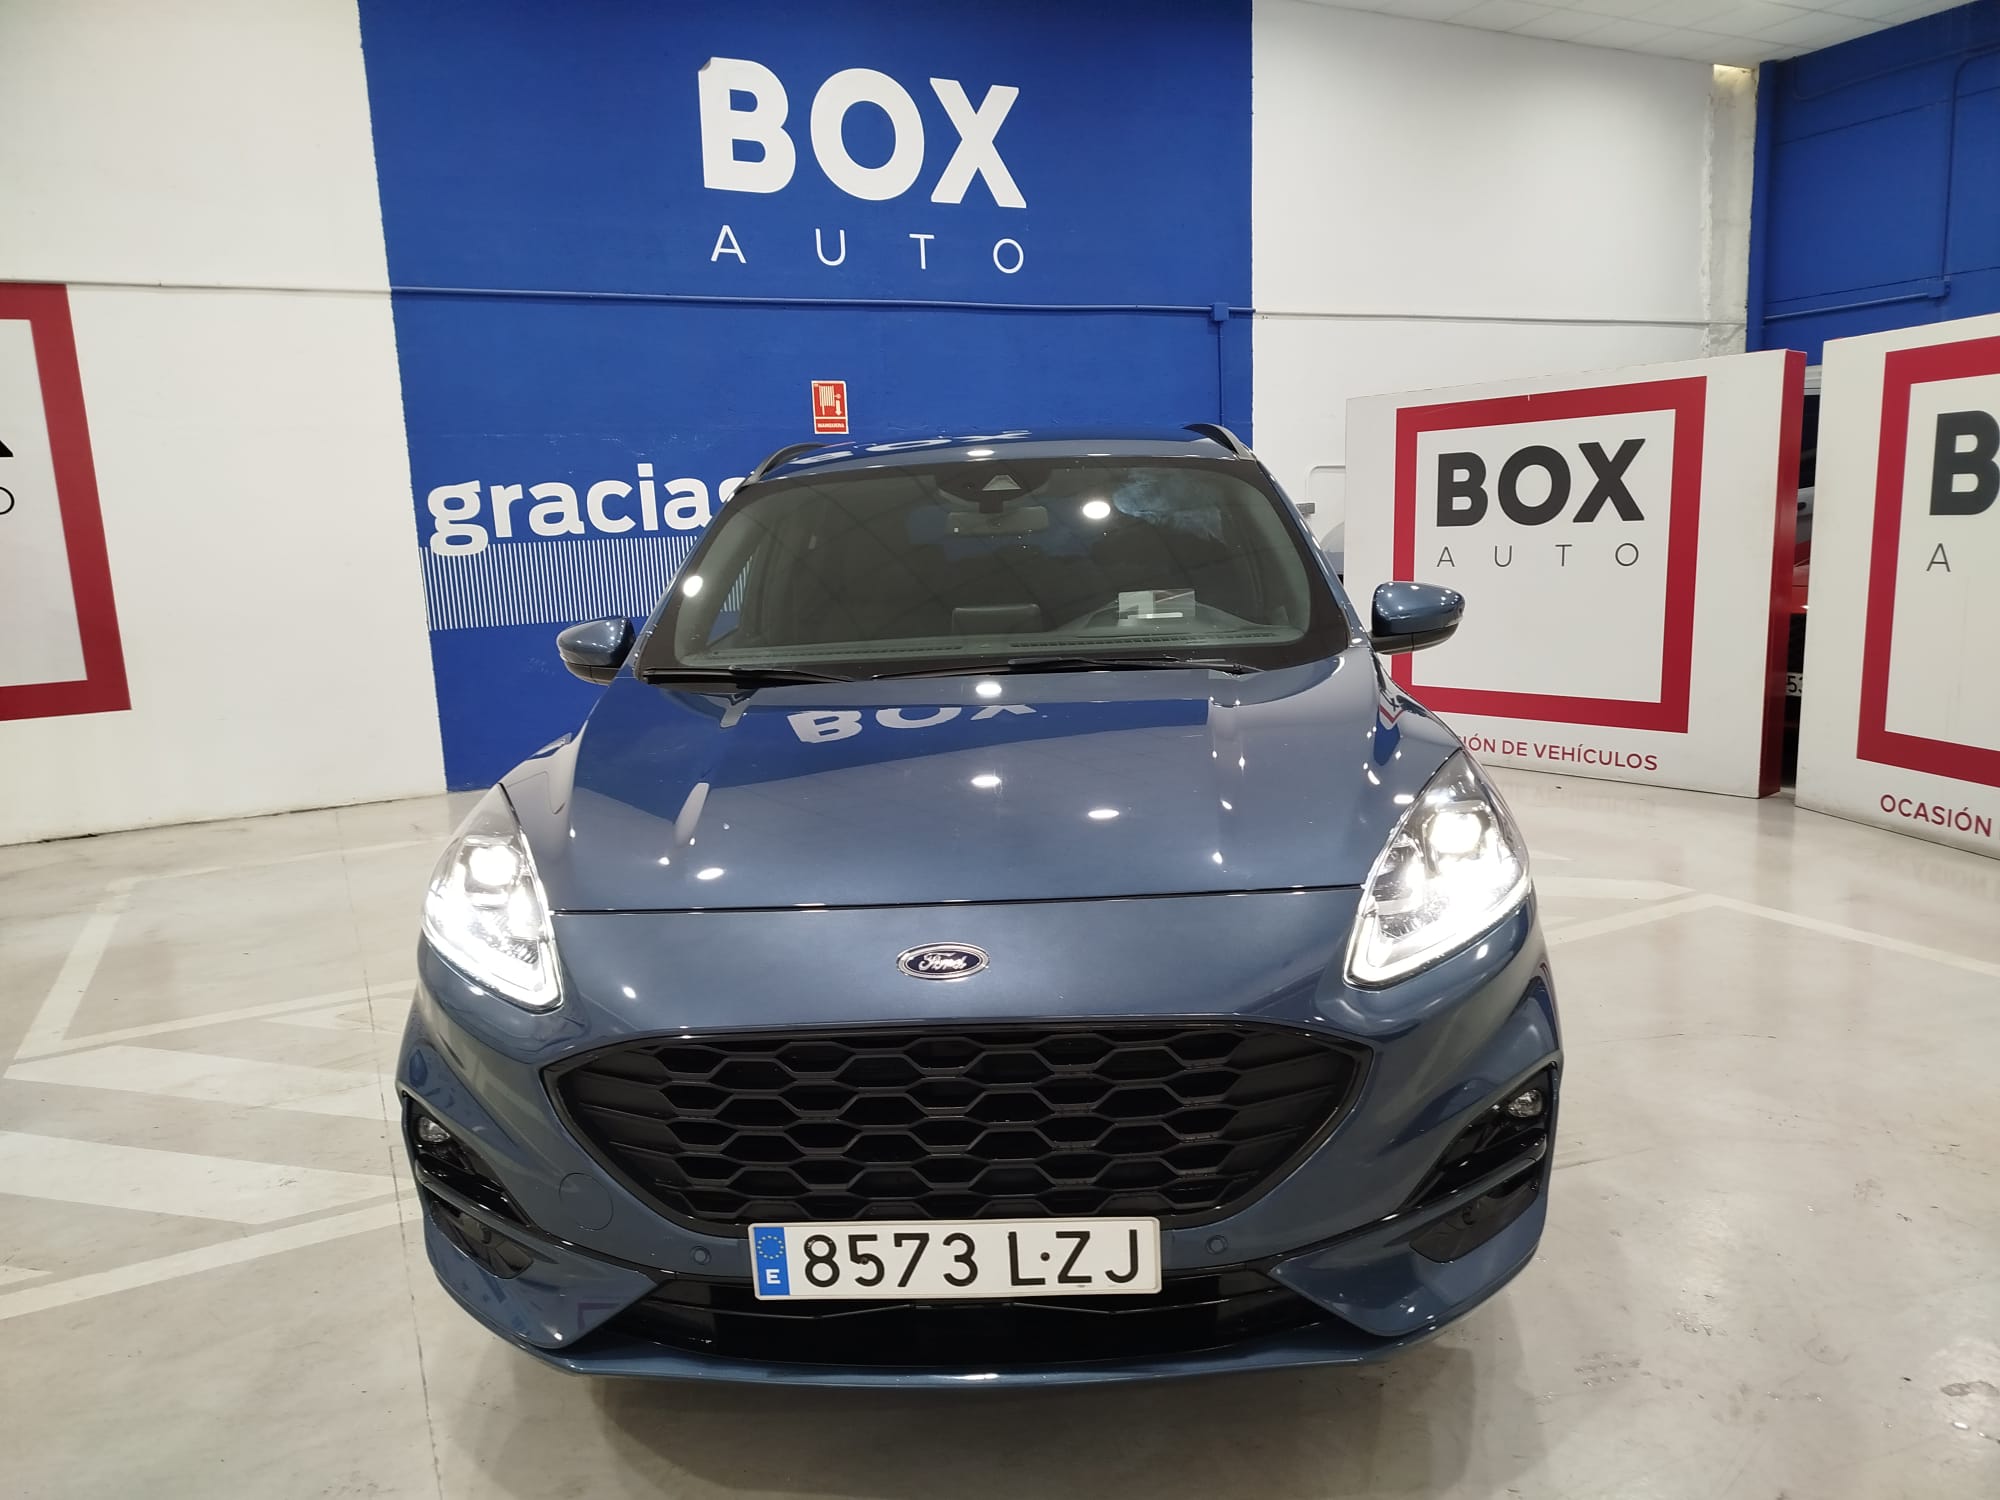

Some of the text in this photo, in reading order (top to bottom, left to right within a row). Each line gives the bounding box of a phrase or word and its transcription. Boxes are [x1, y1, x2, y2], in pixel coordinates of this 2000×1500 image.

[698, 56, 1027, 209] BOX
[710, 224, 1024, 274] AUTO
[1436, 438, 1646, 527] BOX
[1436, 542, 1639, 567] AUTO
[1502, 740, 1528, 756] DE
[1533, 744, 1658, 771] VEHÍCULOS
[1880, 794, 1992, 837] OCASIÓN
[918, 952, 968, 971] Ford
[766, 1269, 781, 1285] E
[804, 1229, 1139, 1288] 8573 LZJ
